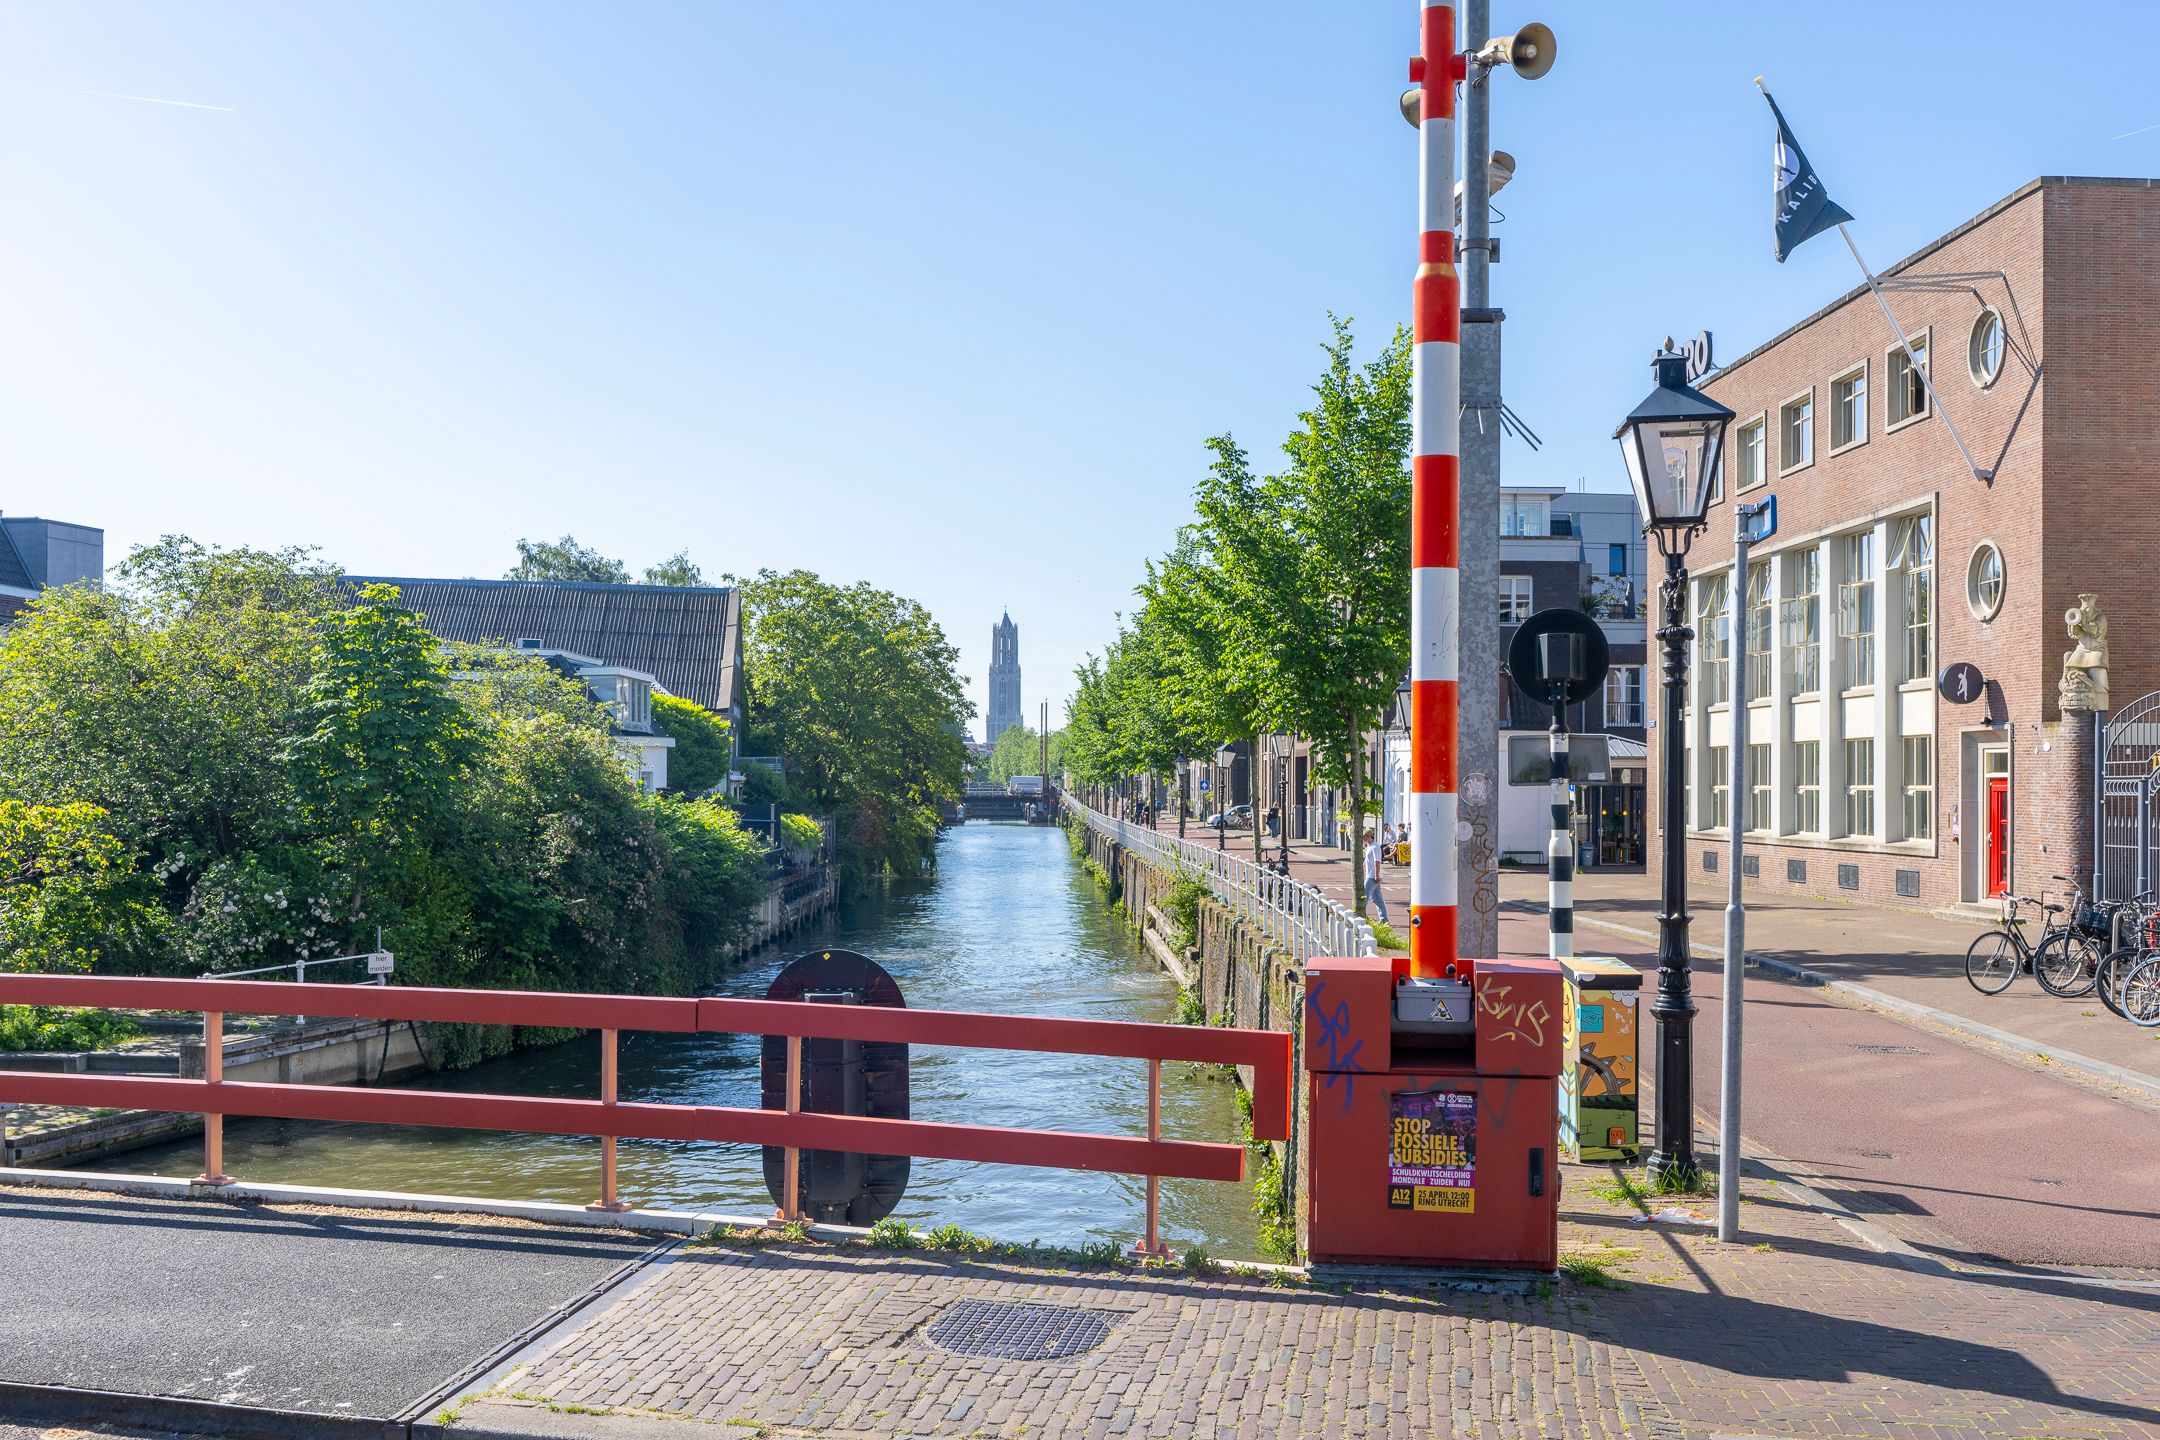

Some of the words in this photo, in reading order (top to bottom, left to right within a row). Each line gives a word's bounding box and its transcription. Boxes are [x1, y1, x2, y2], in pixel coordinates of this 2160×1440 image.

[1393, 1117, 1431, 1134] STOP
[1393, 1133, 1458, 1151] FOSSIELE
[1393, 1148, 1467, 1166] SUBSIDIES
[1392, 1168, 1471, 1179] SCHULDKWIJTSCHELDING
[1391, 1176, 1426, 1185] MONDIALE
[1429, 1178, 1454, 1186] ZUIDEN
[1458, 1179, 1471, 1187] NU!
[1392, 1188, 1410, 1200] A12
[1418, 1190, 1427, 1198] 25
[1428, 1191, 1449, 1199] APRIL
[1451, 1192, 1470, 1200] 12:00
[1418, 1198, 1436, 1207] RING
[1438, 1199, 1470, 1208] UTRECHT
